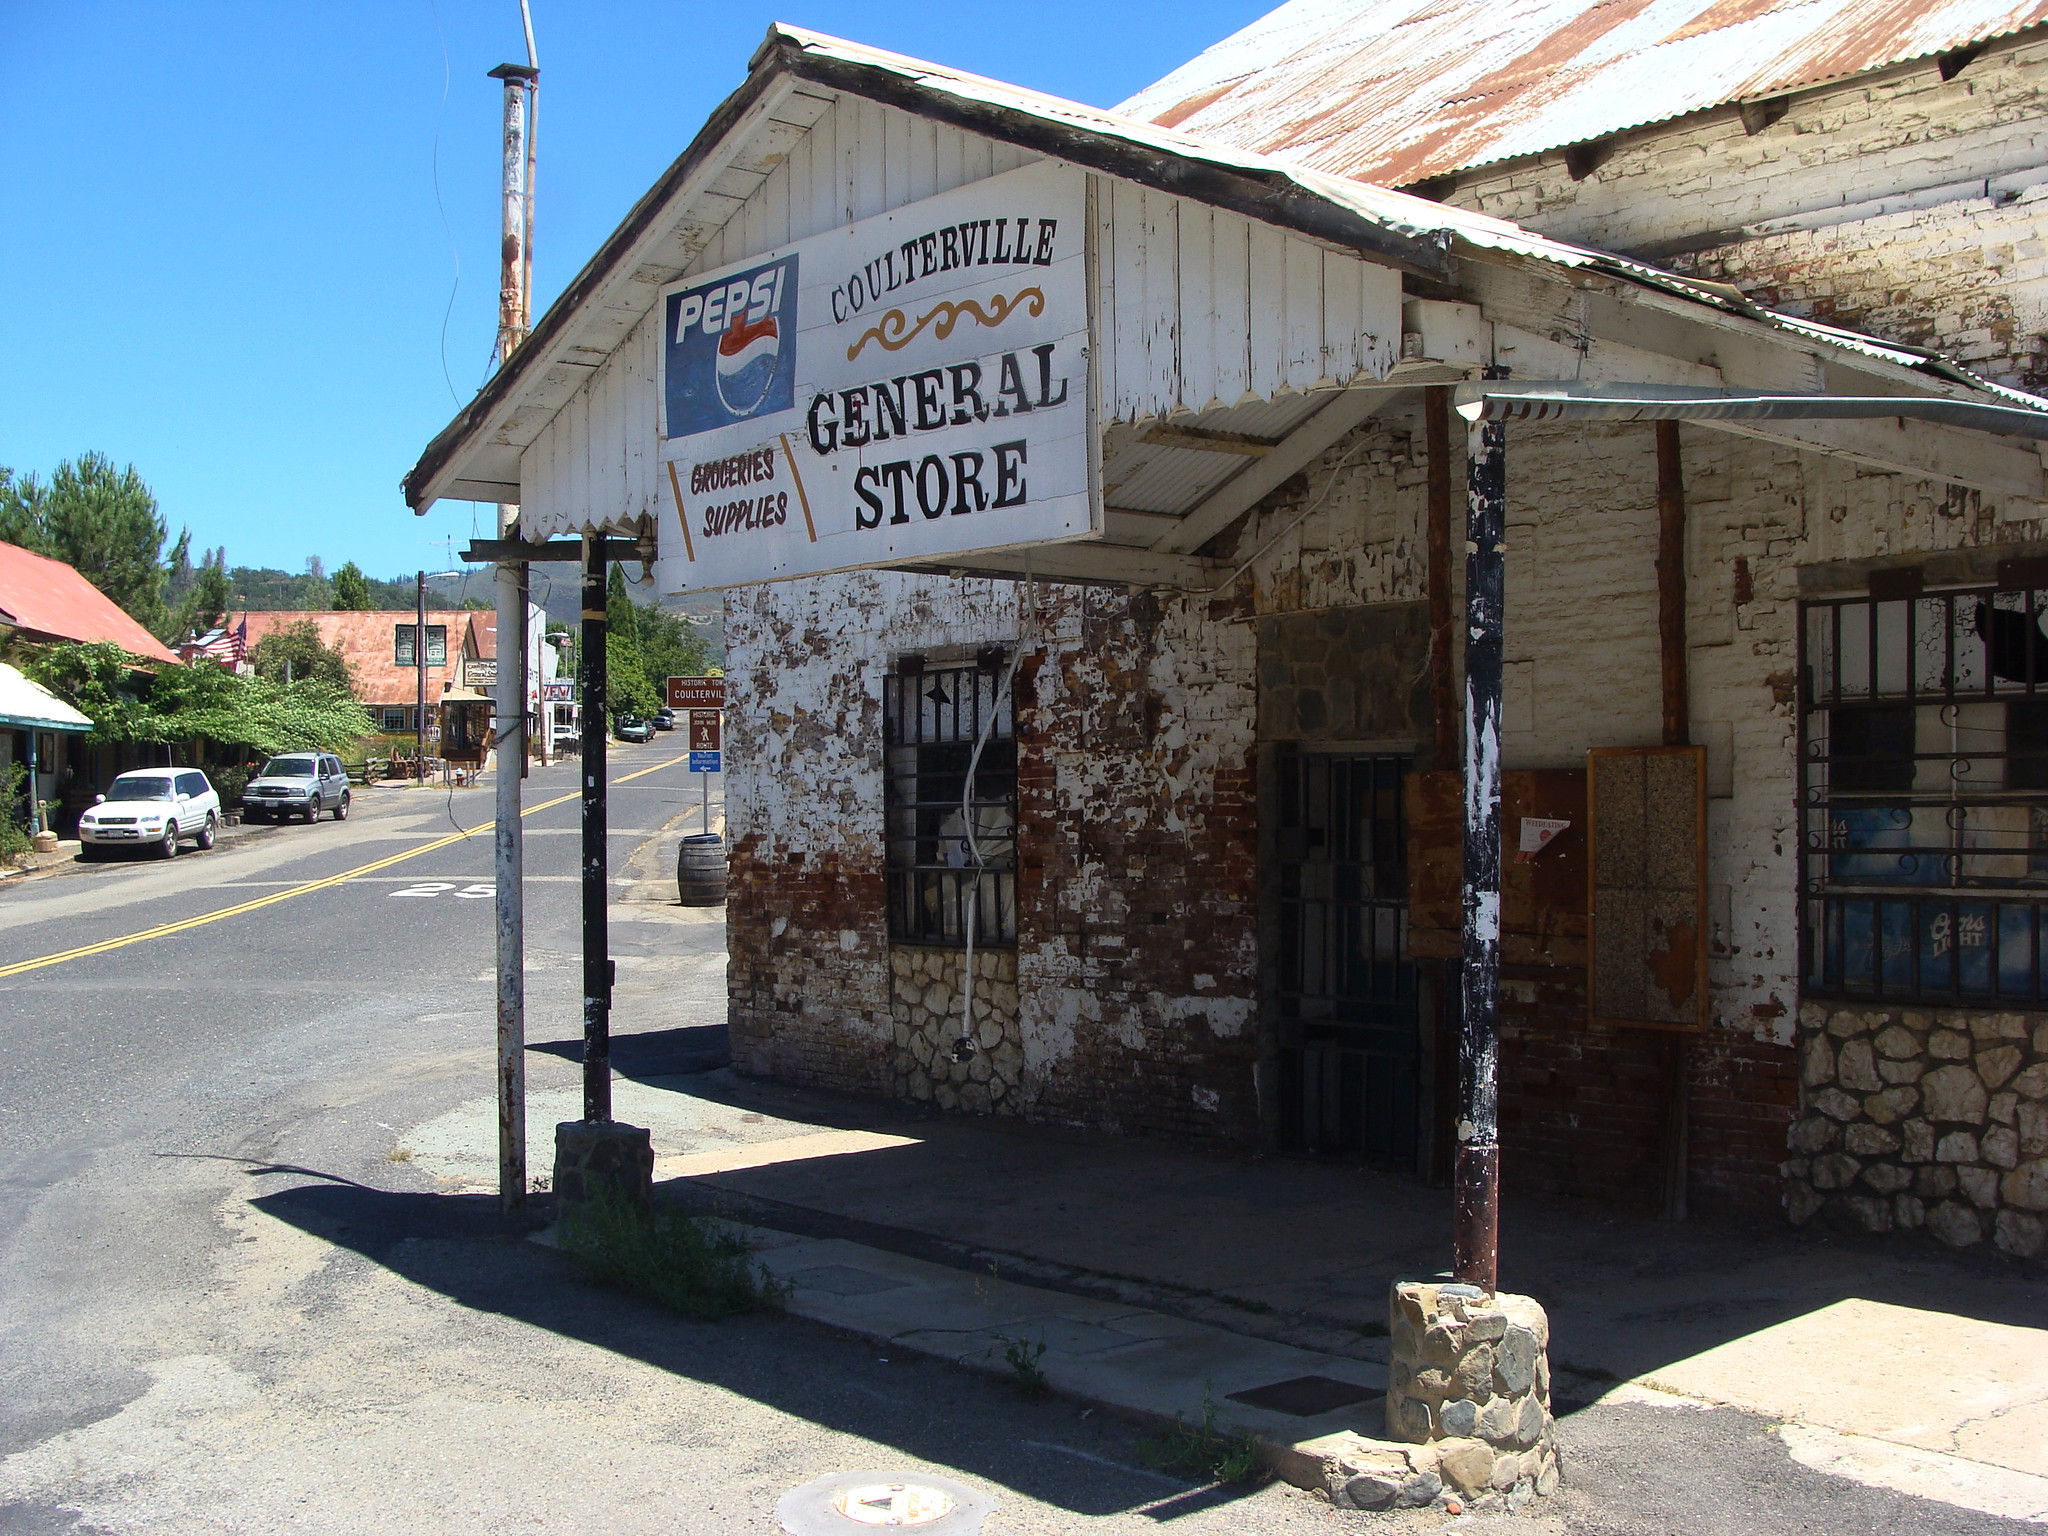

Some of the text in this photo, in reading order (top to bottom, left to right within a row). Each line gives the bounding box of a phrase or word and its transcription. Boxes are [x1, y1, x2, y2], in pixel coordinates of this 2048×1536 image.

[831, 218, 1058, 324] COULTERVILLE
[676, 265, 786, 344] PEPSI
[807, 343, 1068, 455] GENERAL
[691, 448, 774, 495] GROCERIES
[855, 439, 1027, 531] STORE
[703, 491, 788, 537] SUPPLIES
[674, 690, 725, 699] COULTERVIL
[389, 882, 496, 899] 25
